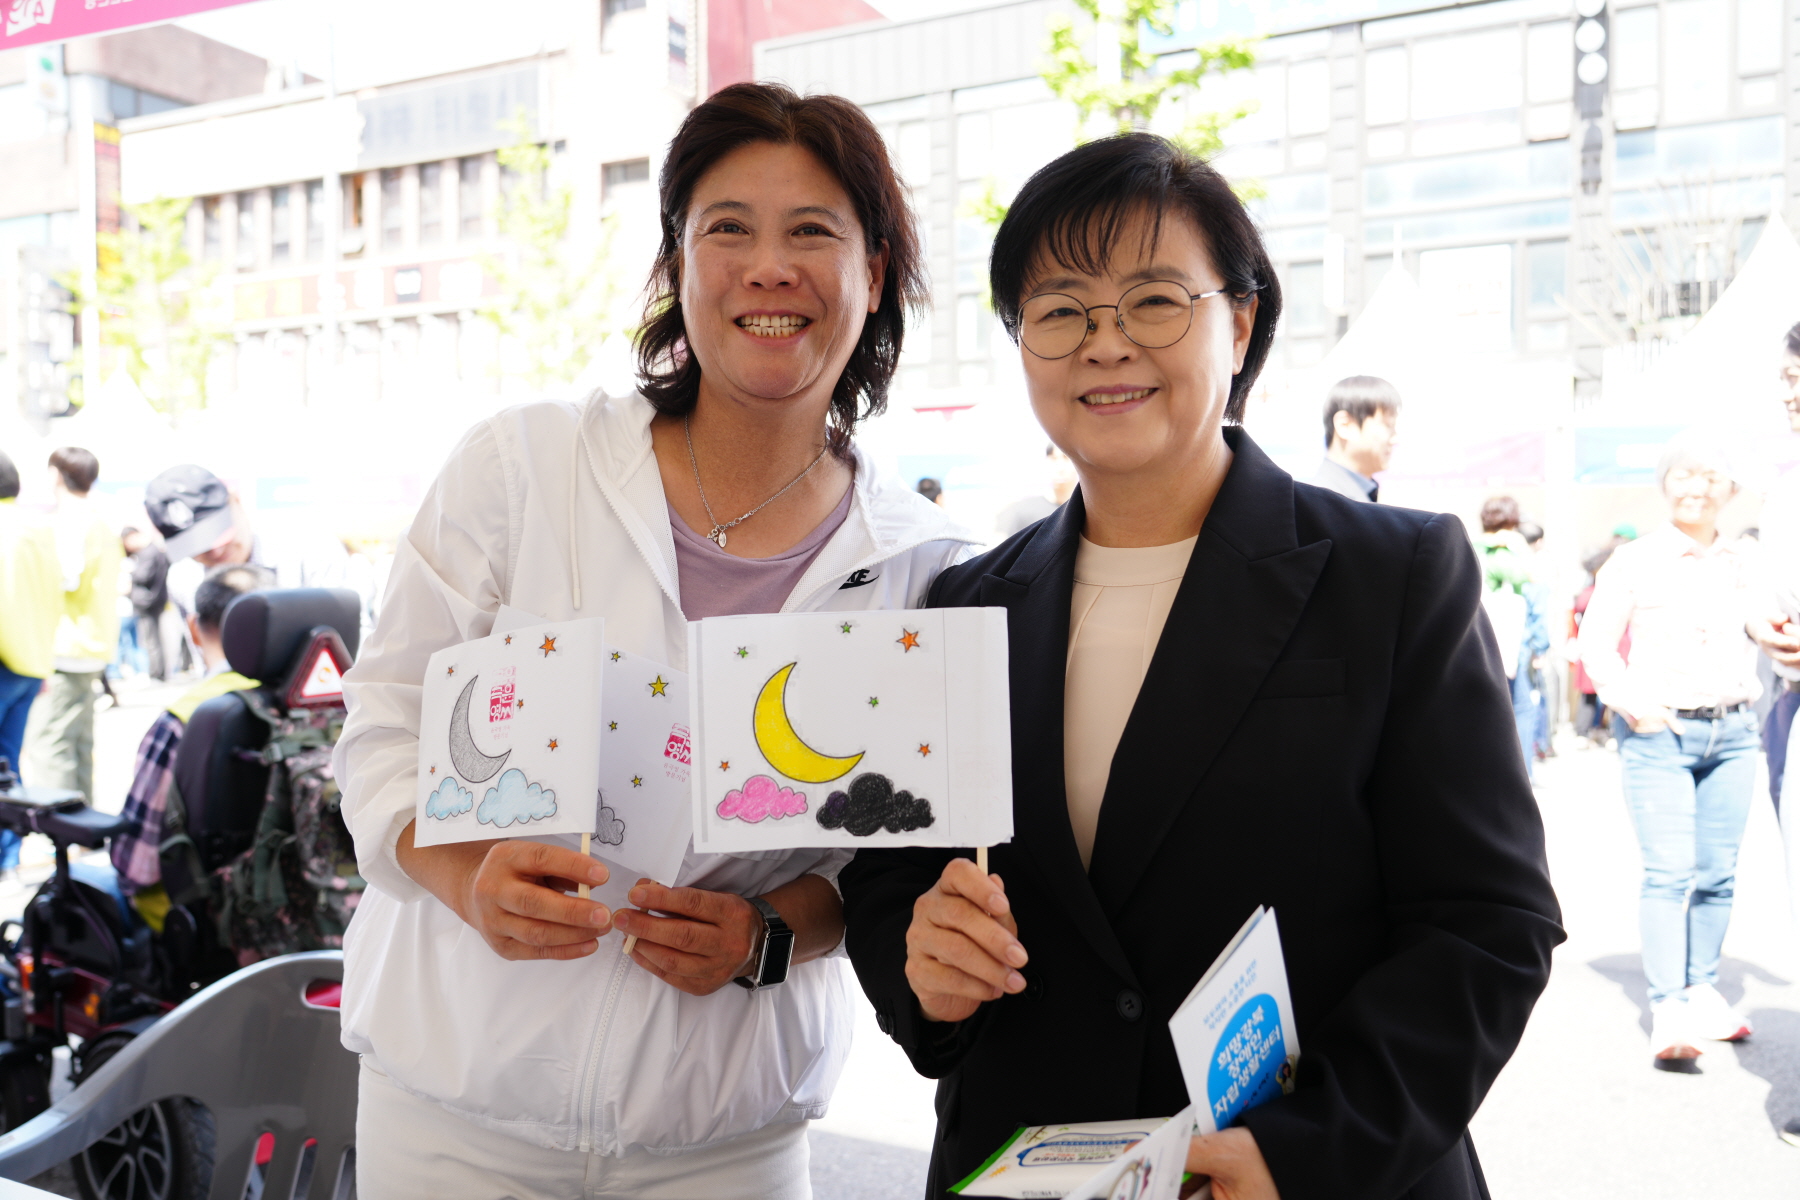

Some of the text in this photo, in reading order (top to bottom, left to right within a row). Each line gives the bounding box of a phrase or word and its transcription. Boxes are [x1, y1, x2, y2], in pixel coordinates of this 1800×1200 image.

[1213, 1023, 1281, 1119] 자립생활센터
[1217, 1004, 1265, 1071] 희망강북
[1227, 1028, 1263, 1080] 장애인
